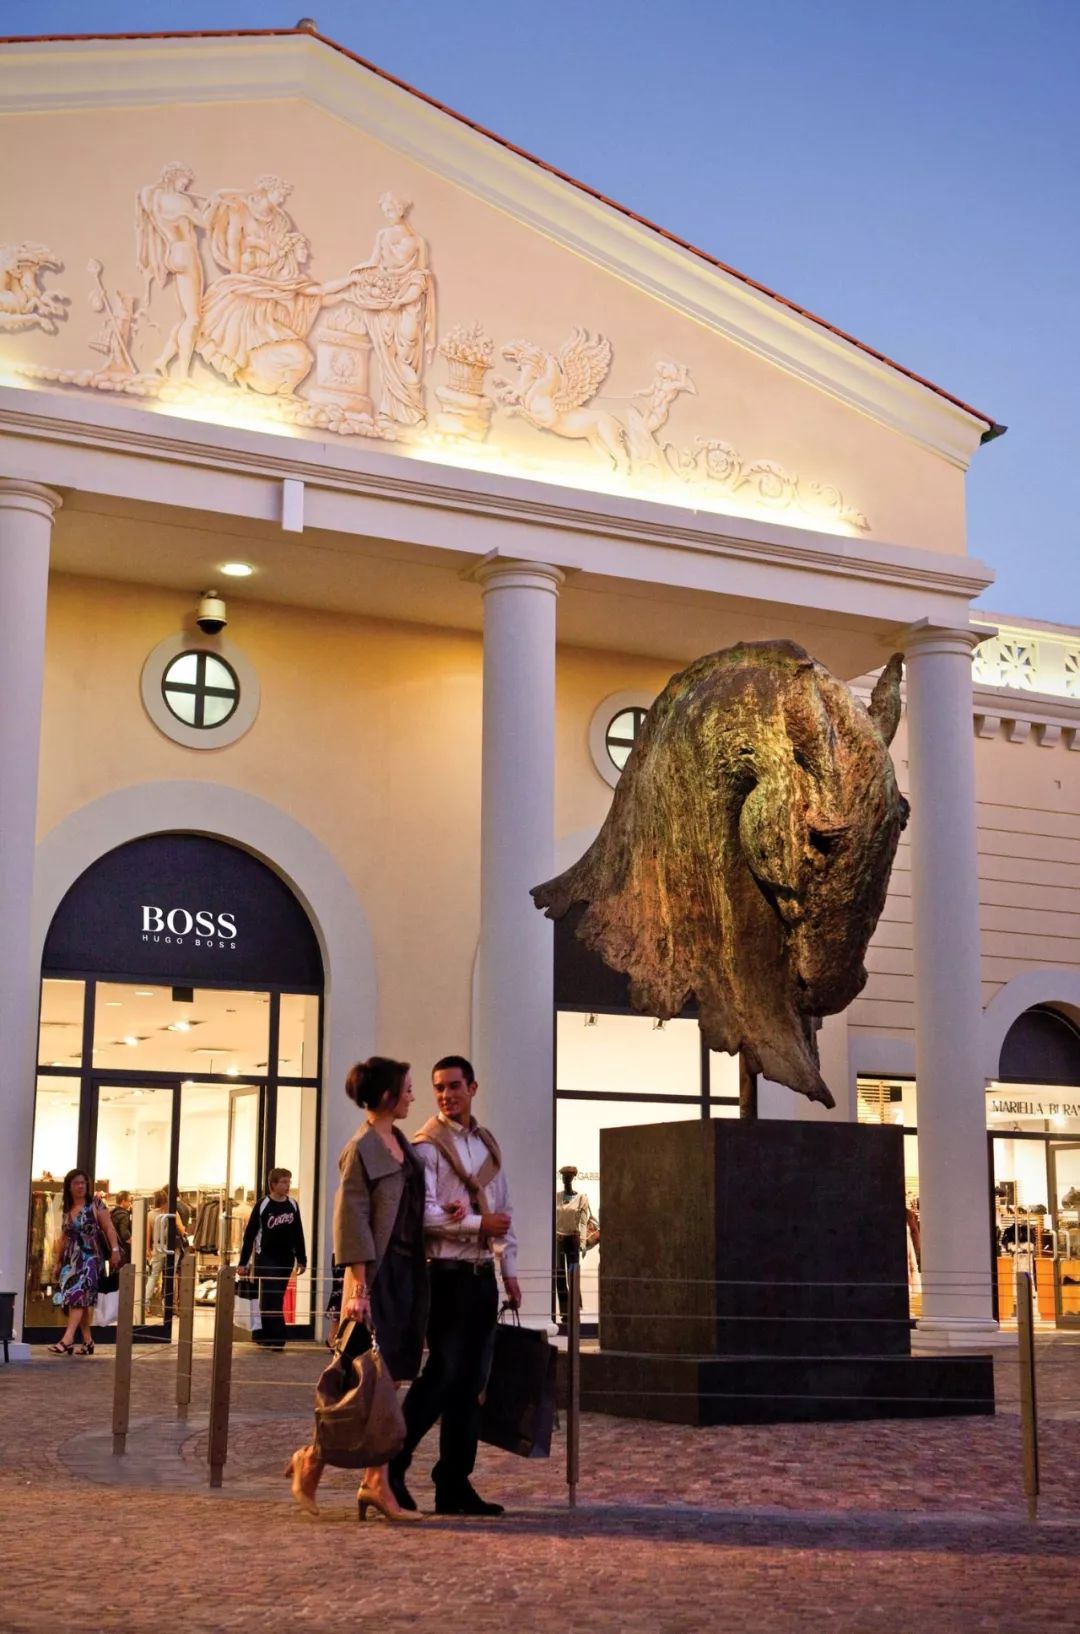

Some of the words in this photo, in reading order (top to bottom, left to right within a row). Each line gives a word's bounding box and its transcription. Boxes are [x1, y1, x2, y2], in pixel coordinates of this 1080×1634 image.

[141, 905, 238, 939] BOSS
[142, 934, 183, 945] HUGO
[195, 939, 236, 950] BOSS
